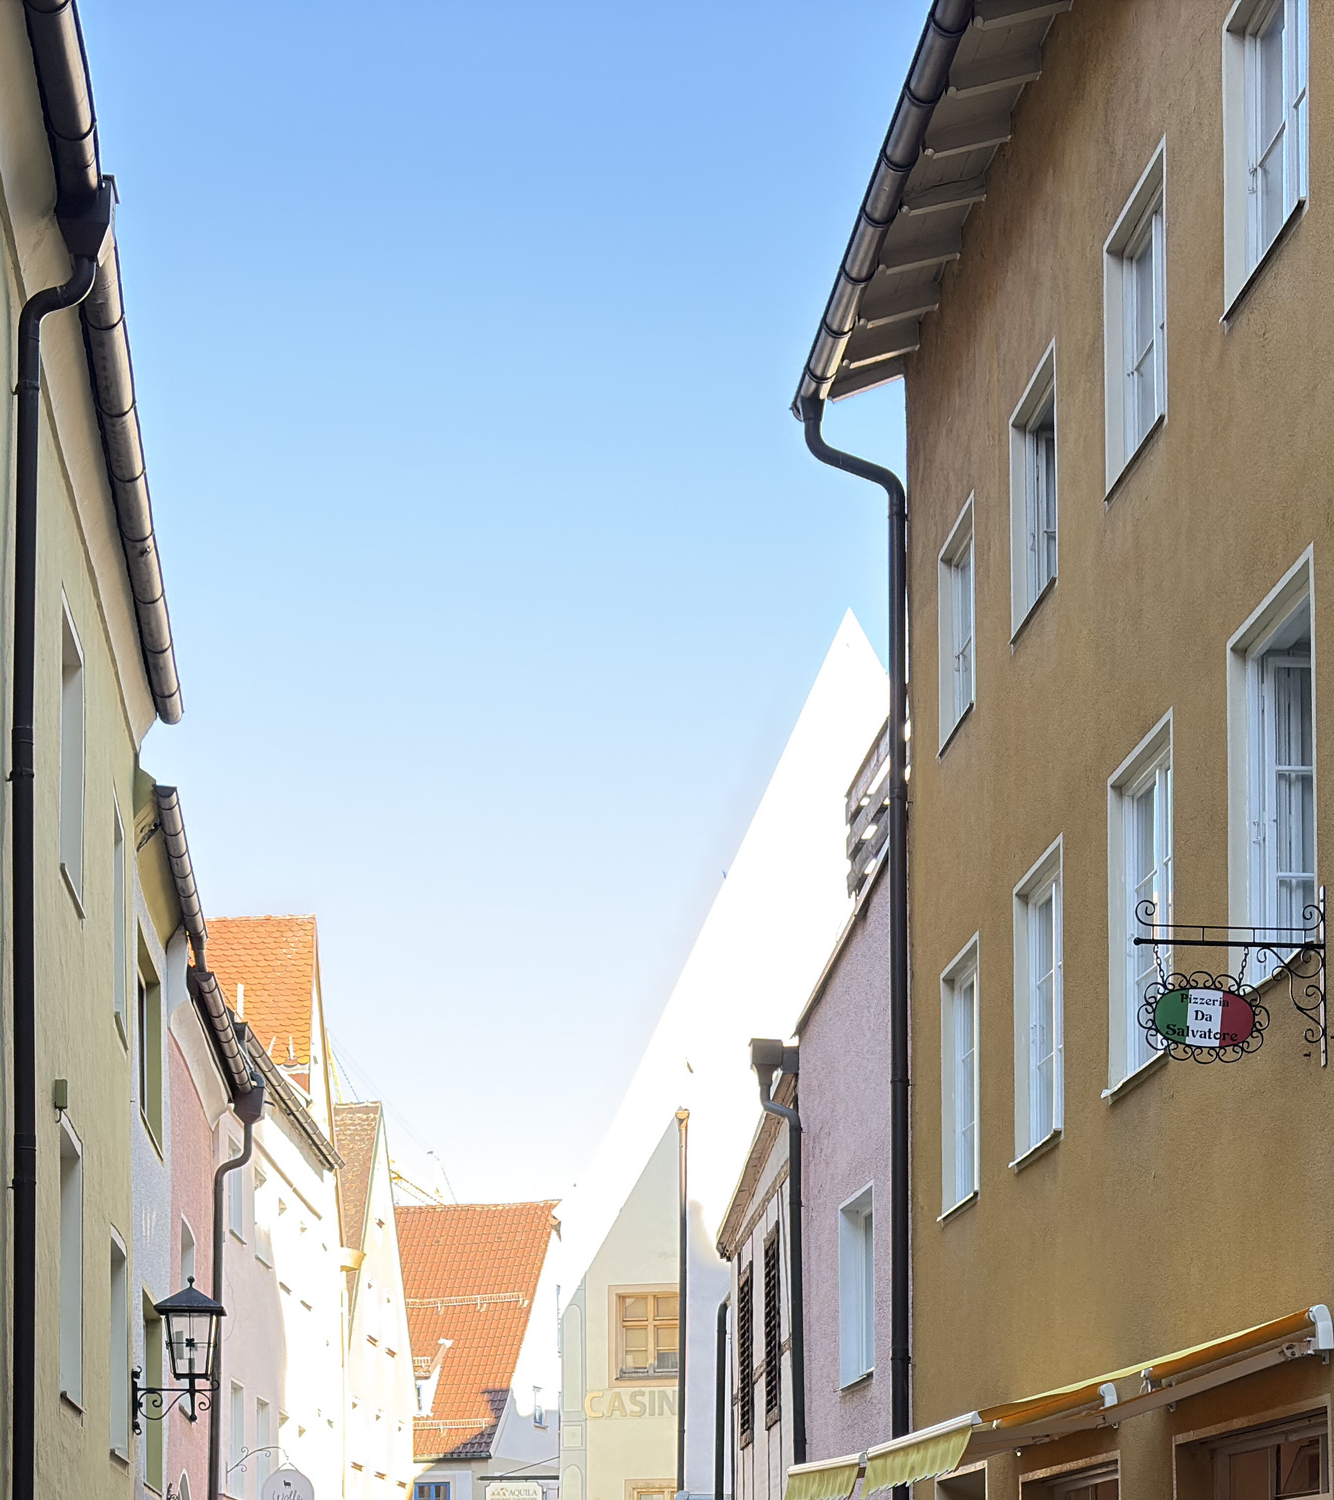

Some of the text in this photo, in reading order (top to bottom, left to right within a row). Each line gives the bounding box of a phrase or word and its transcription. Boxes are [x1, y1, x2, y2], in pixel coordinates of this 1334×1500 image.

[1180, 993, 1229, 1008] Pizzeria
[1194, 1010, 1212, 1022] Da
[1166, 1023, 1238, 1042] Salvatore
[508, 1489, 537, 1497] AQUILA
